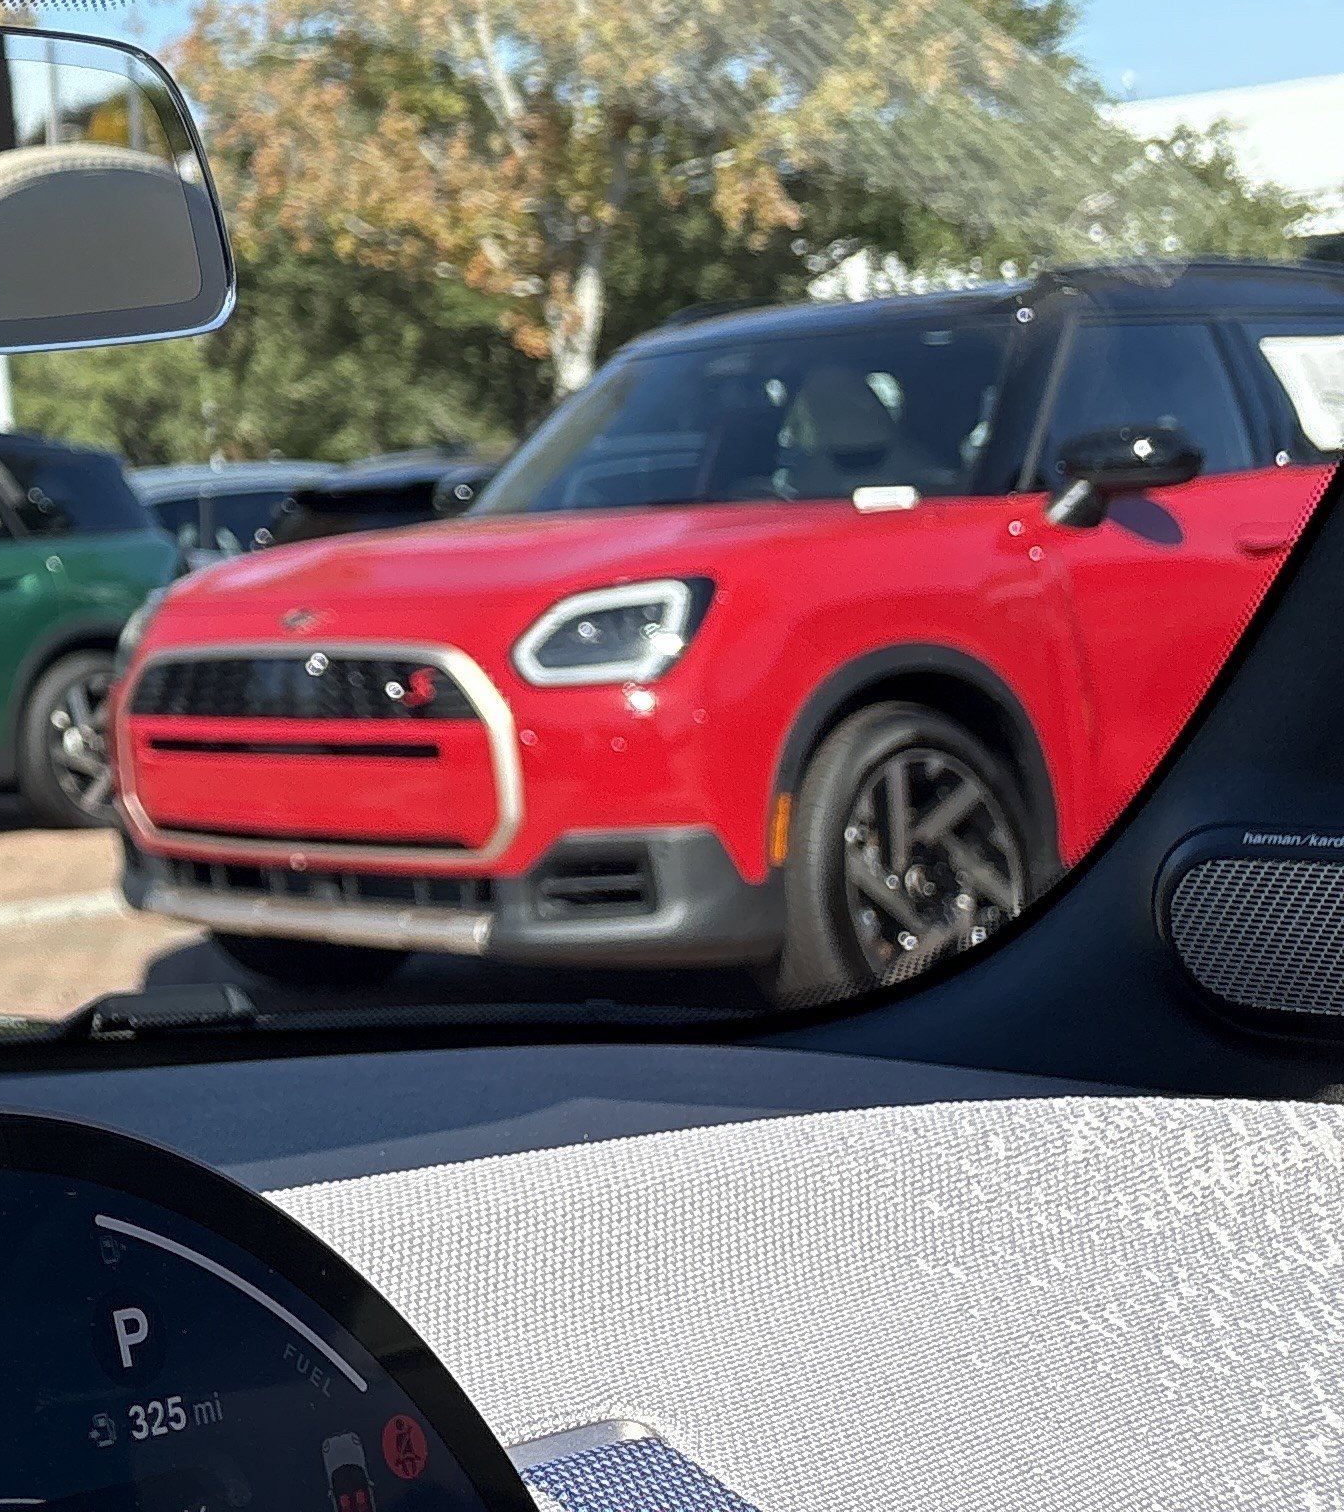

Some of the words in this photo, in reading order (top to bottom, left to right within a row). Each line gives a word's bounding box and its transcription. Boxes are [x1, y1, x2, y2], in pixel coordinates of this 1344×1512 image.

[113, 1307, 150, 1368] P
[283, 1343, 332, 1398] FUEL
[128, 1395, 188, 1439] 325
[193, 1391, 224, 1426] mi
